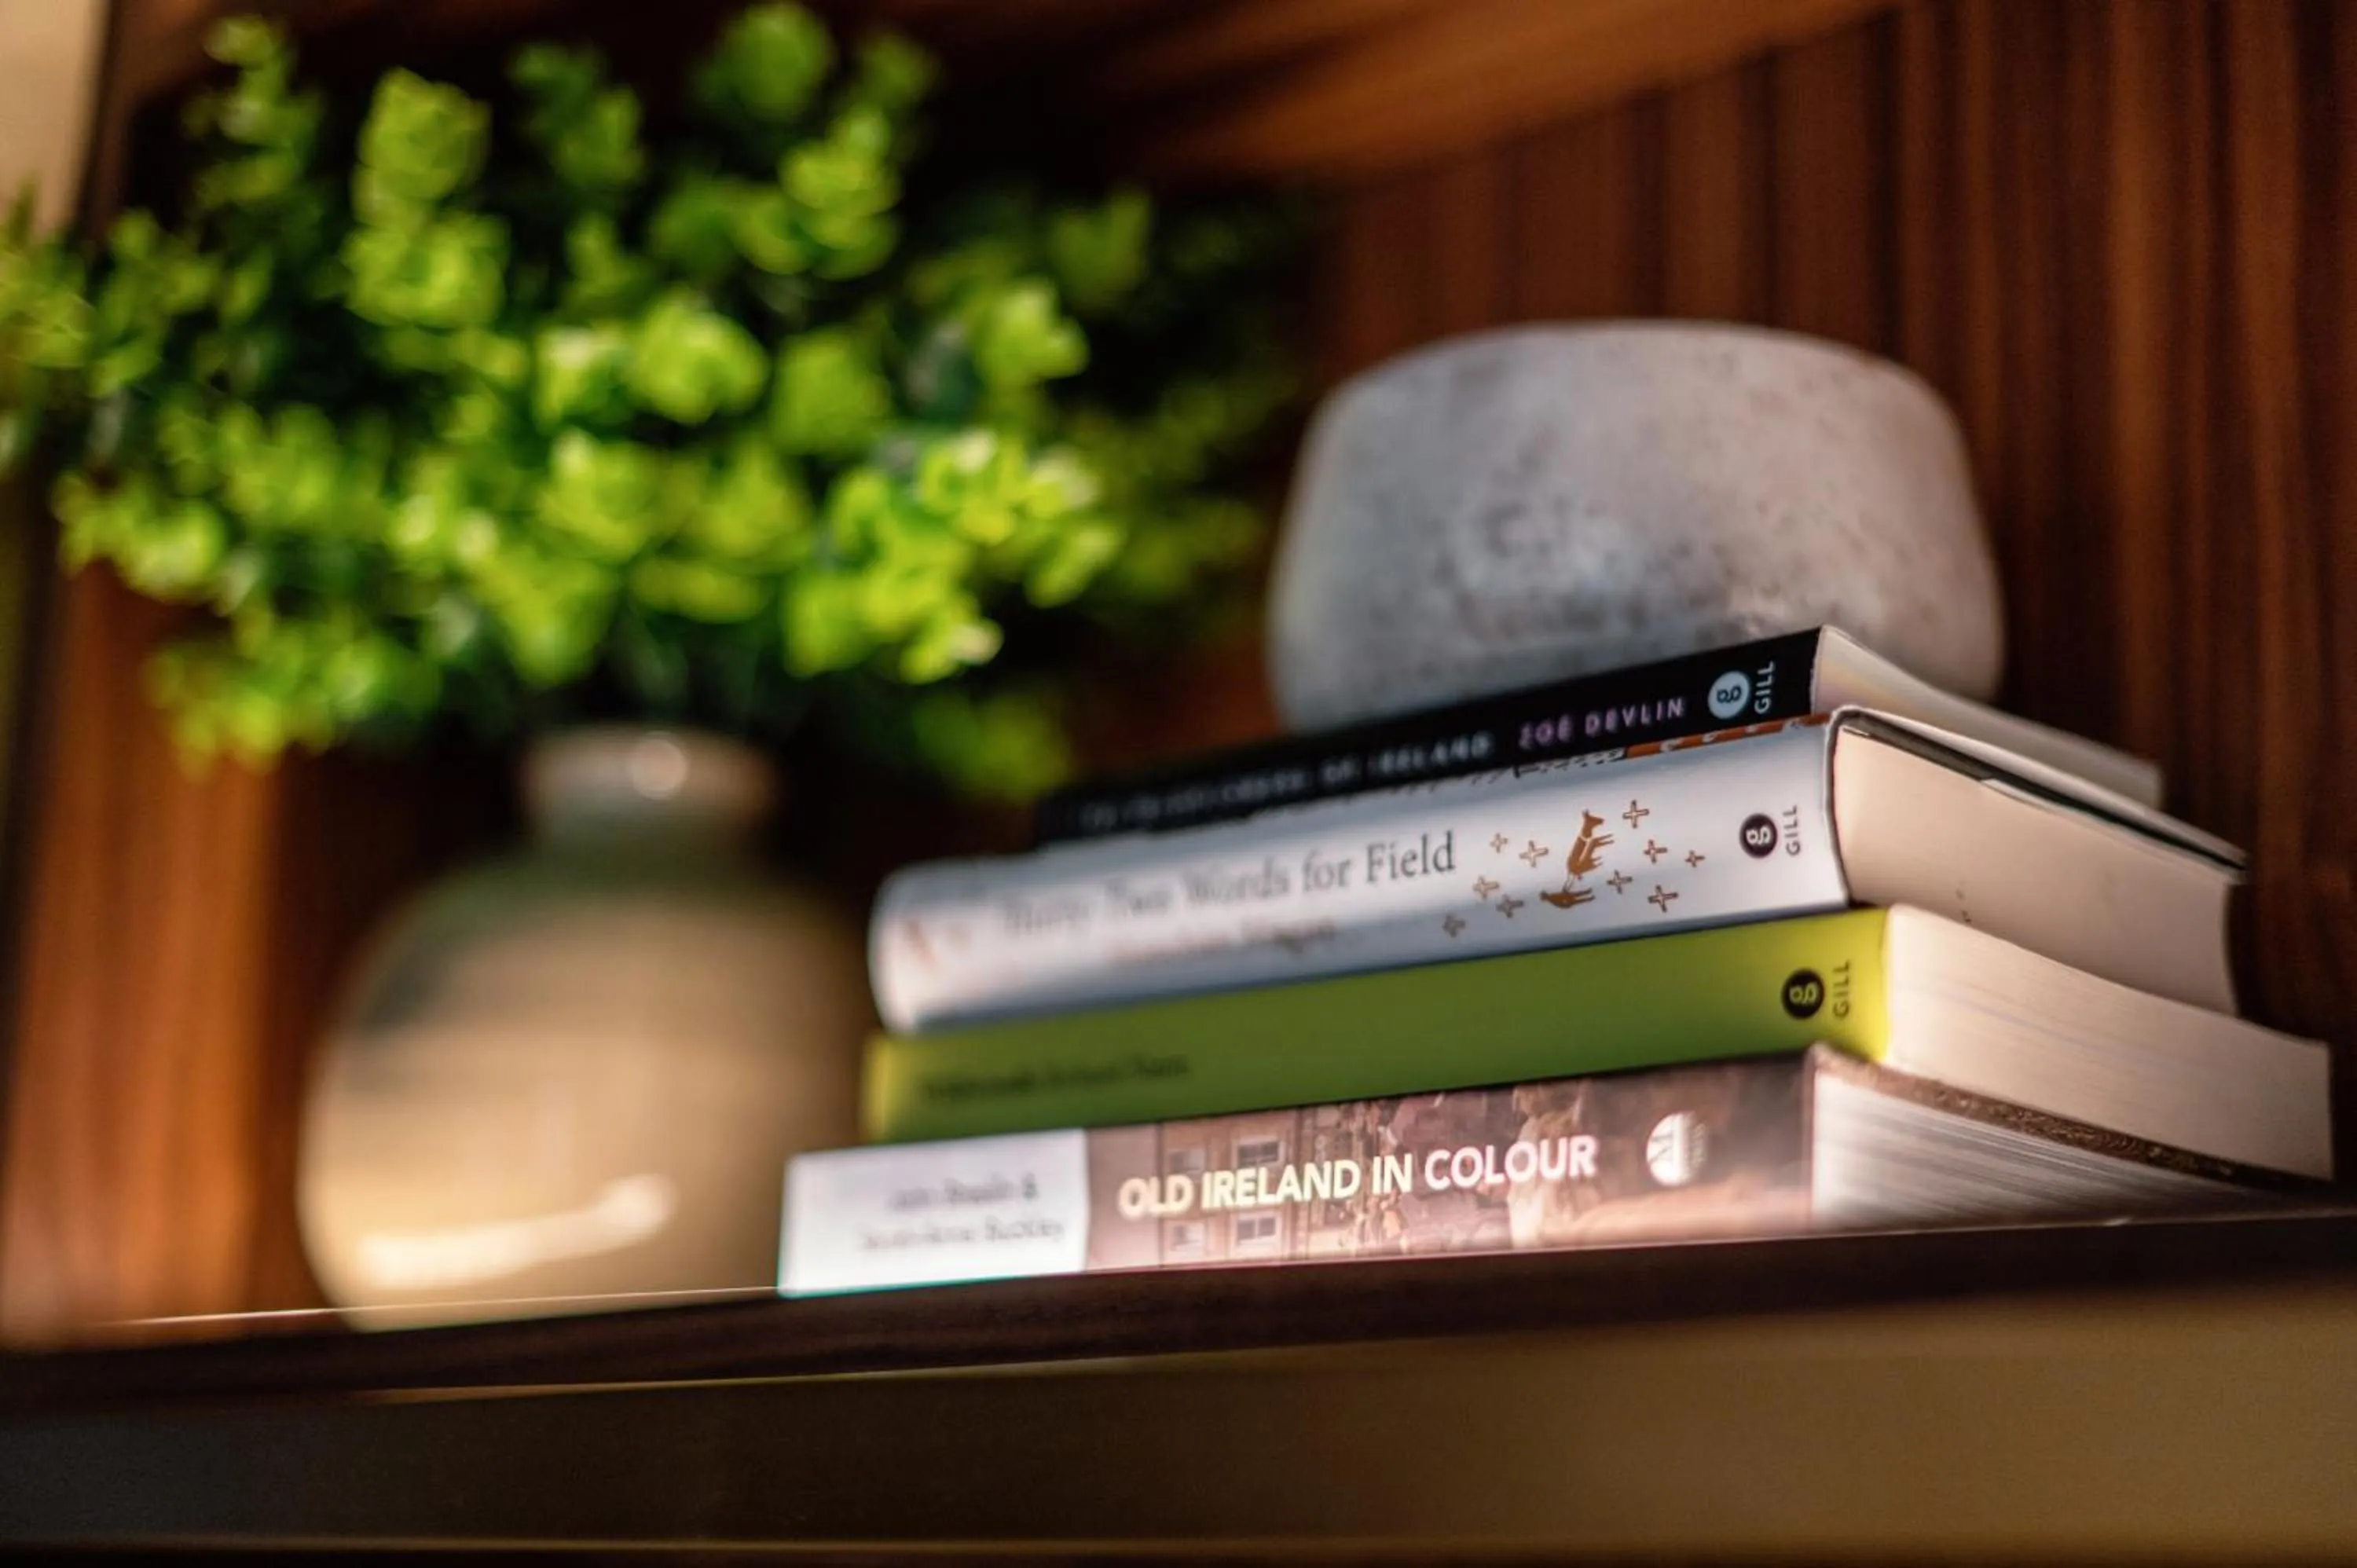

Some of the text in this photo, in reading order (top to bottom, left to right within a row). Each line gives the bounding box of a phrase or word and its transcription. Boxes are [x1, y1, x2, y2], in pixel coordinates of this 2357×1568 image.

[1754, 661, 1776, 715] GILL
[1585, 697, 1684, 737] DEVLIN
[1785, 804, 1801, 855] GILL
[1301, 848, 1353, 892] for
[1365, 830, 1457, 885] Field
[1832, 959, 1851, 1019] GILL
[1118, 1135, 1598, 1220] OLD IRELAND IN COLOUR
